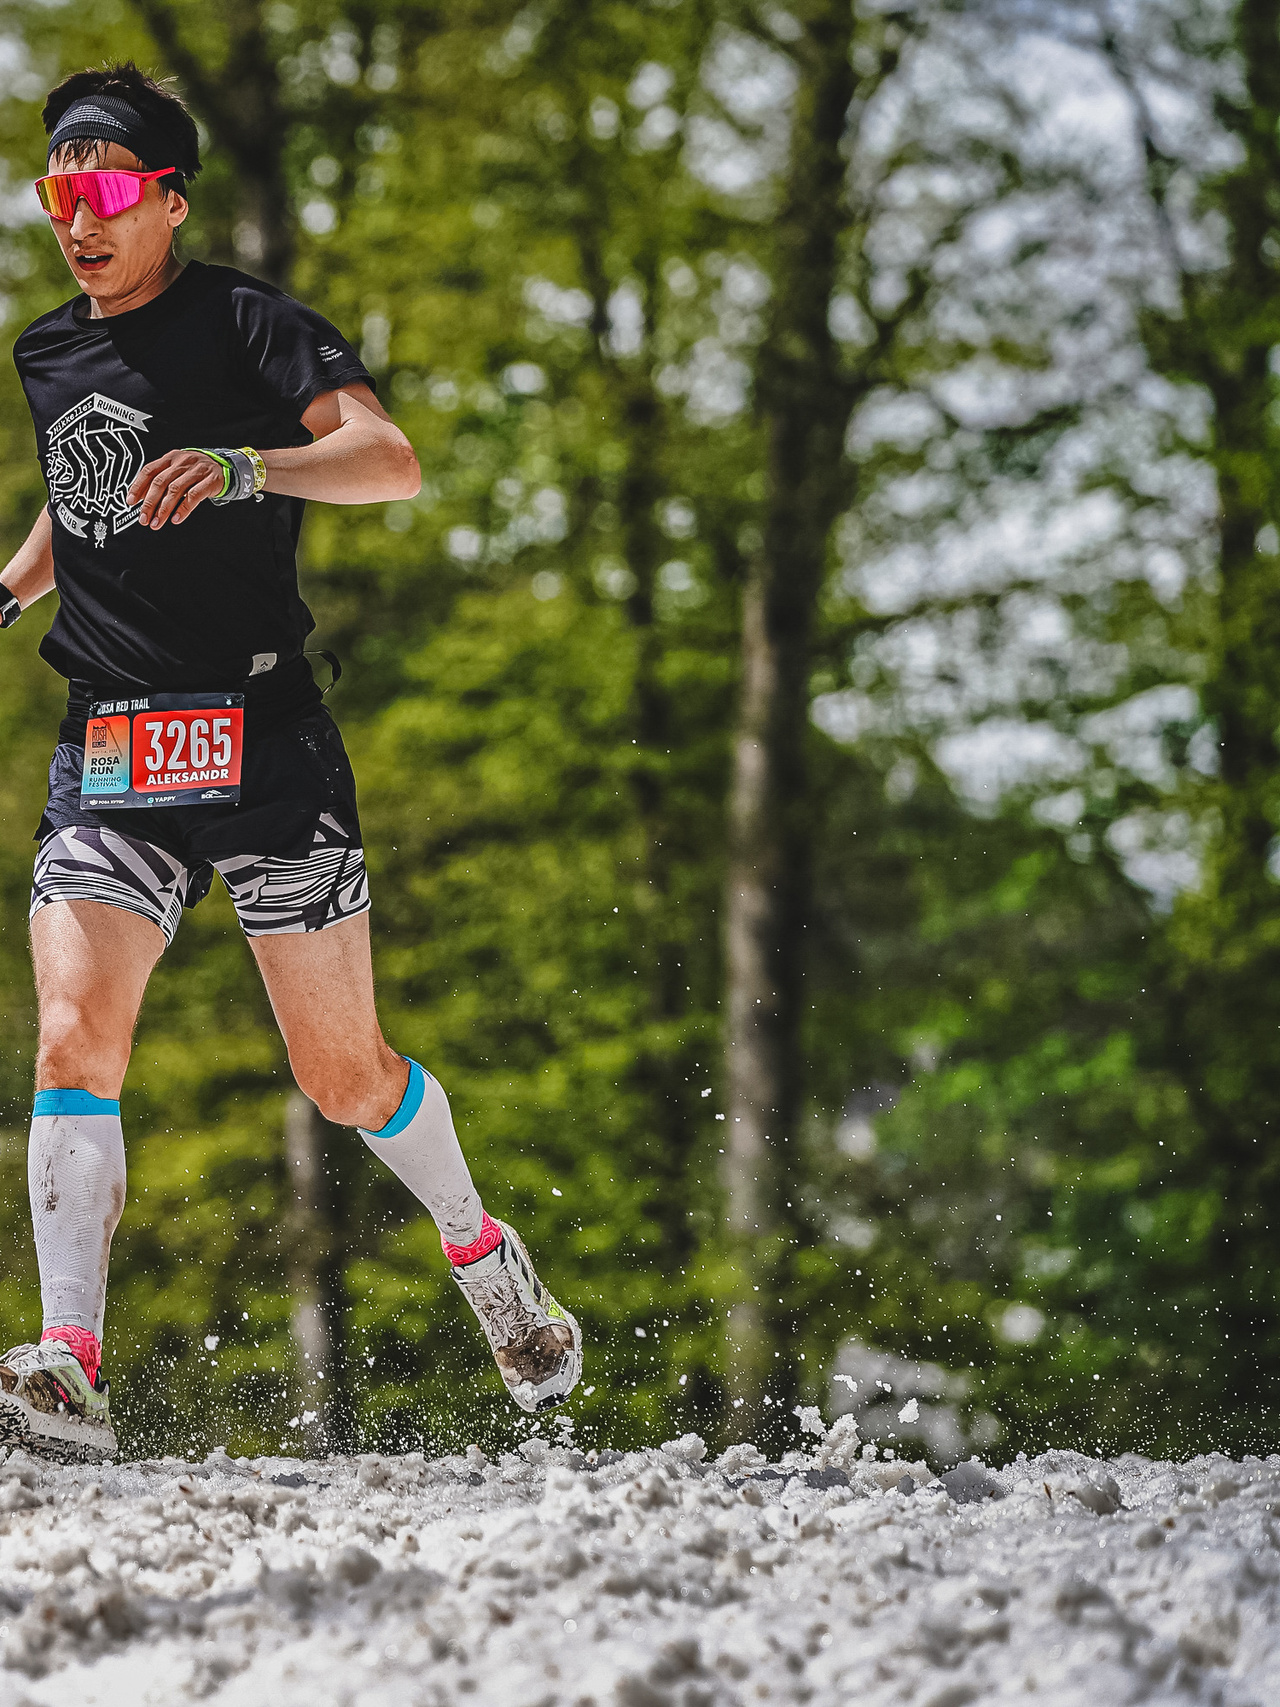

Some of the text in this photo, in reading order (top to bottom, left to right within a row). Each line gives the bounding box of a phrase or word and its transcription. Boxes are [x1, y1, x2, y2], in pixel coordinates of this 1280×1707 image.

[97, 399, 136, 422] RUNNING
[60, 508, 78, 529] CLUB
[116, 701, 129, 712] RED
[130, 698, 150, 711] TRAIL
[145, 718, 232, 772] 3265
[91, 756, 120, 766] ROSA
[90, 766, 113, 775] RUN
[146, 769, 229, 786] ALEKSANDR
[154, 795, 177, 803] YAPPY
